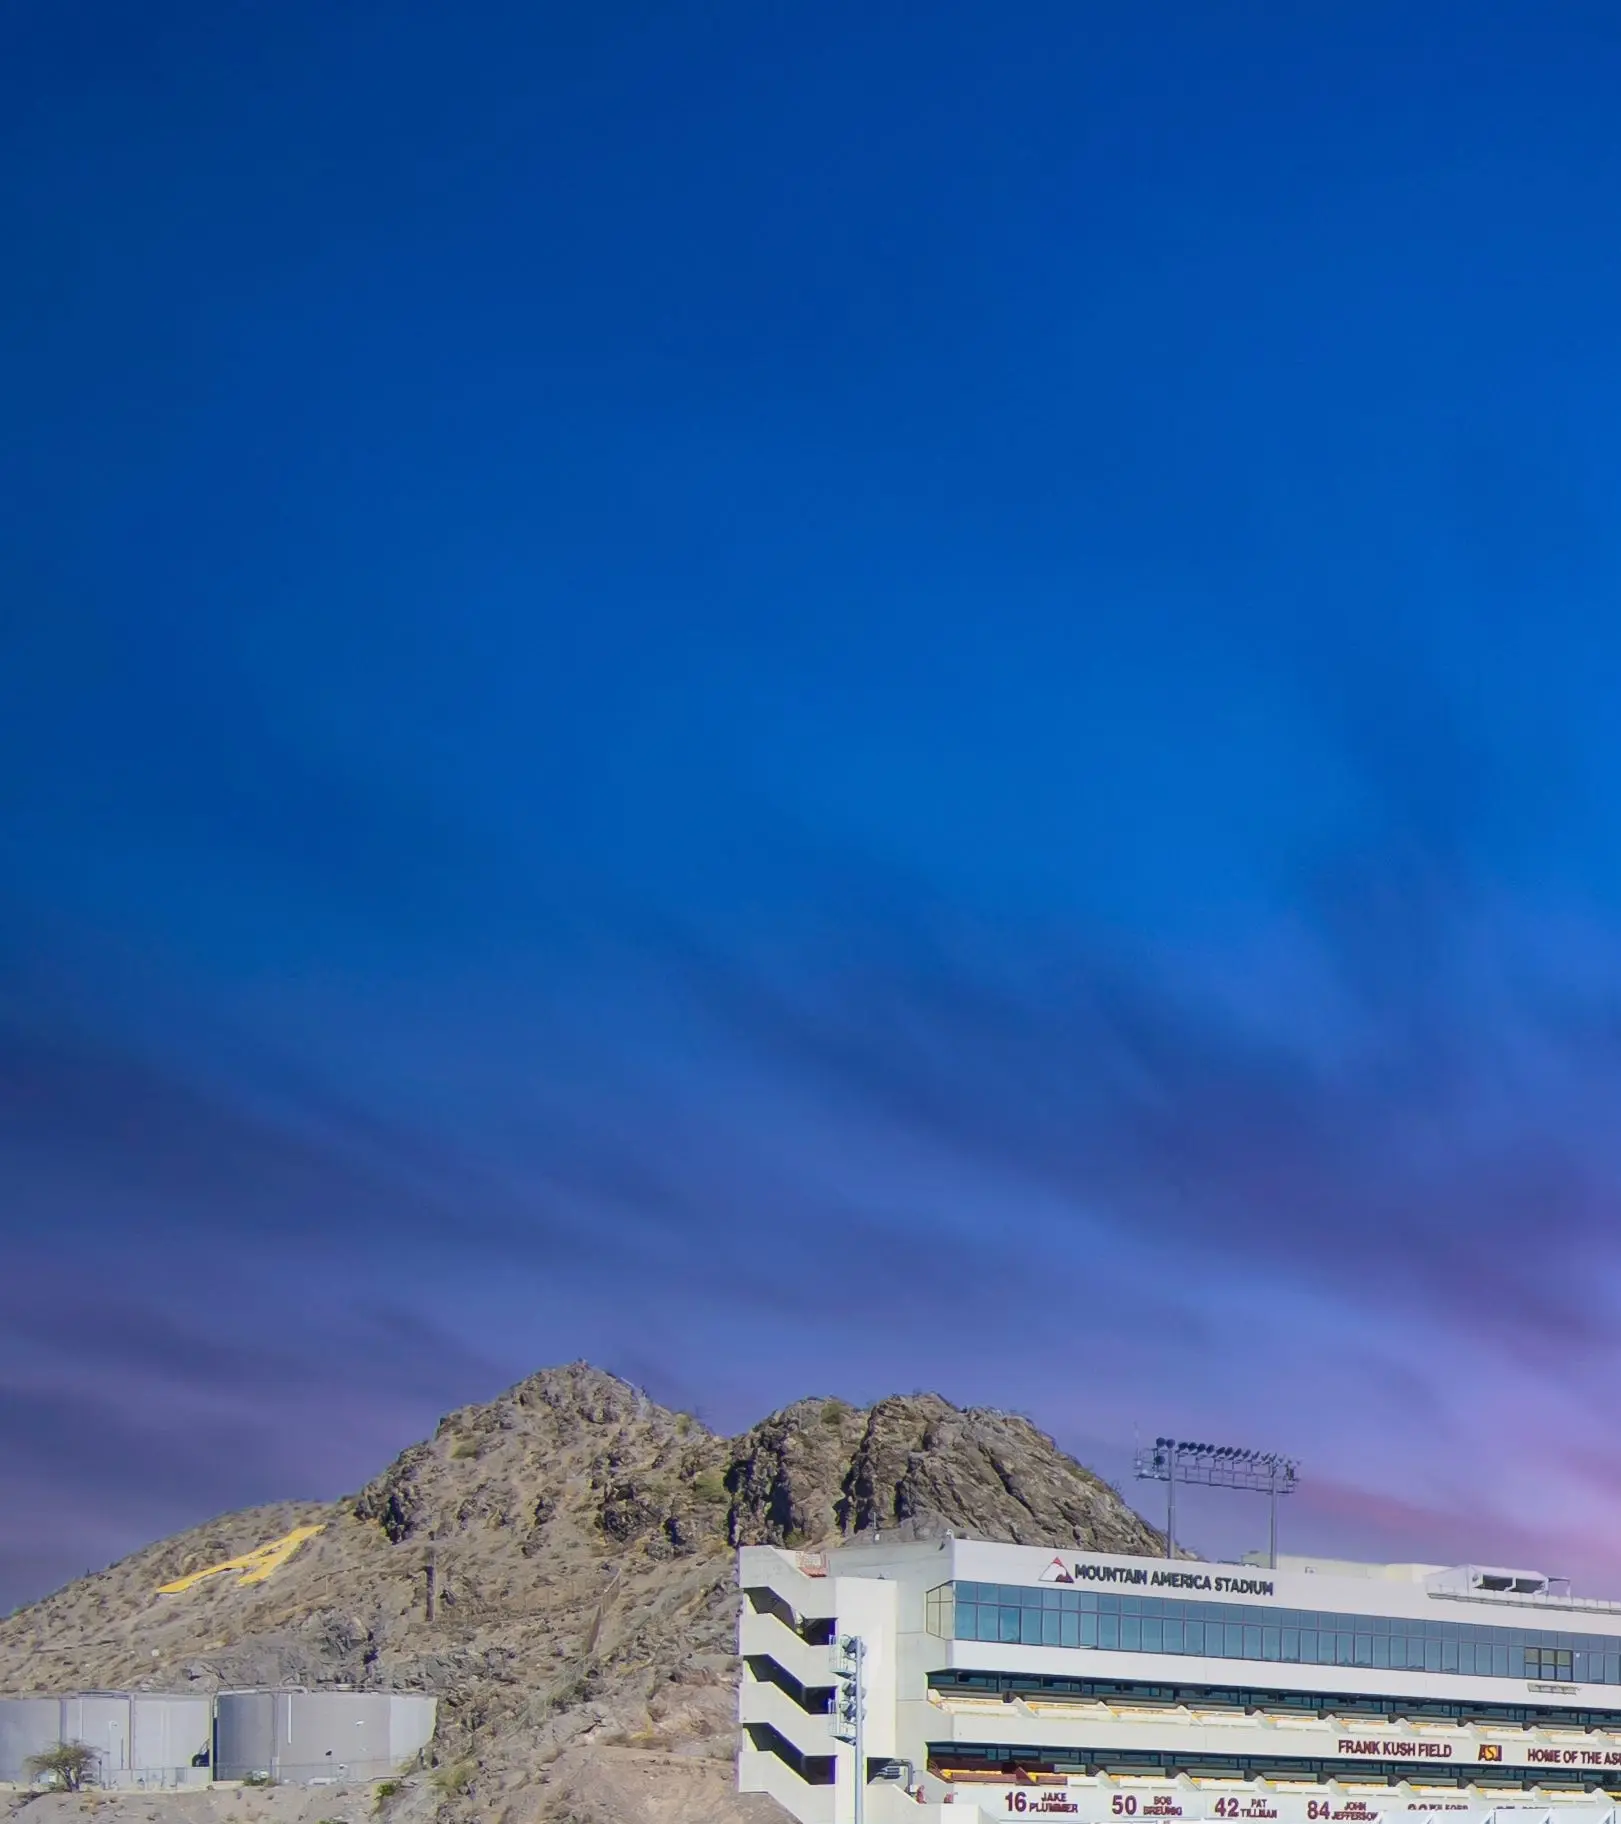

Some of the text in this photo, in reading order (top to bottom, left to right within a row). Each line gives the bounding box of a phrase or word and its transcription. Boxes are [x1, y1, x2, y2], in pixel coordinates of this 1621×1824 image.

[1074, 1563, 1274, 1597] MOUNTAIN AMERICA STADIUM
[1338, 1739, 1452, 1758] FRANK KUSH FIELD
[1478, 1744, 1502, 1761] ASU
[1527, 1748, 1561, 1763] HOME
[1563, 1749, 1578, 1764] OF
[1580, 1750, 1602, 1765] THE
[1005, 1791, 1028, 1813] 16
[1040, 1791, 1068, 1803] JAKE
[1112, 1794, 1137, 1815] 50
[1153, 1796, 1172, 1806] BOB
[1250, 1798, 1268, 1808] PAT
[1029, 1803, 1079, 1813] PLUMMER
[1143, 1805, 1183, 1816] BREUNIG
[1214, 1797, 1239, 1818] 42
[1240, 1808, 1278, 1819] TILLMAN
[1307, 1800, 1331, 1821] 84
[1344, 1801, 1367, 1811] JOHN
